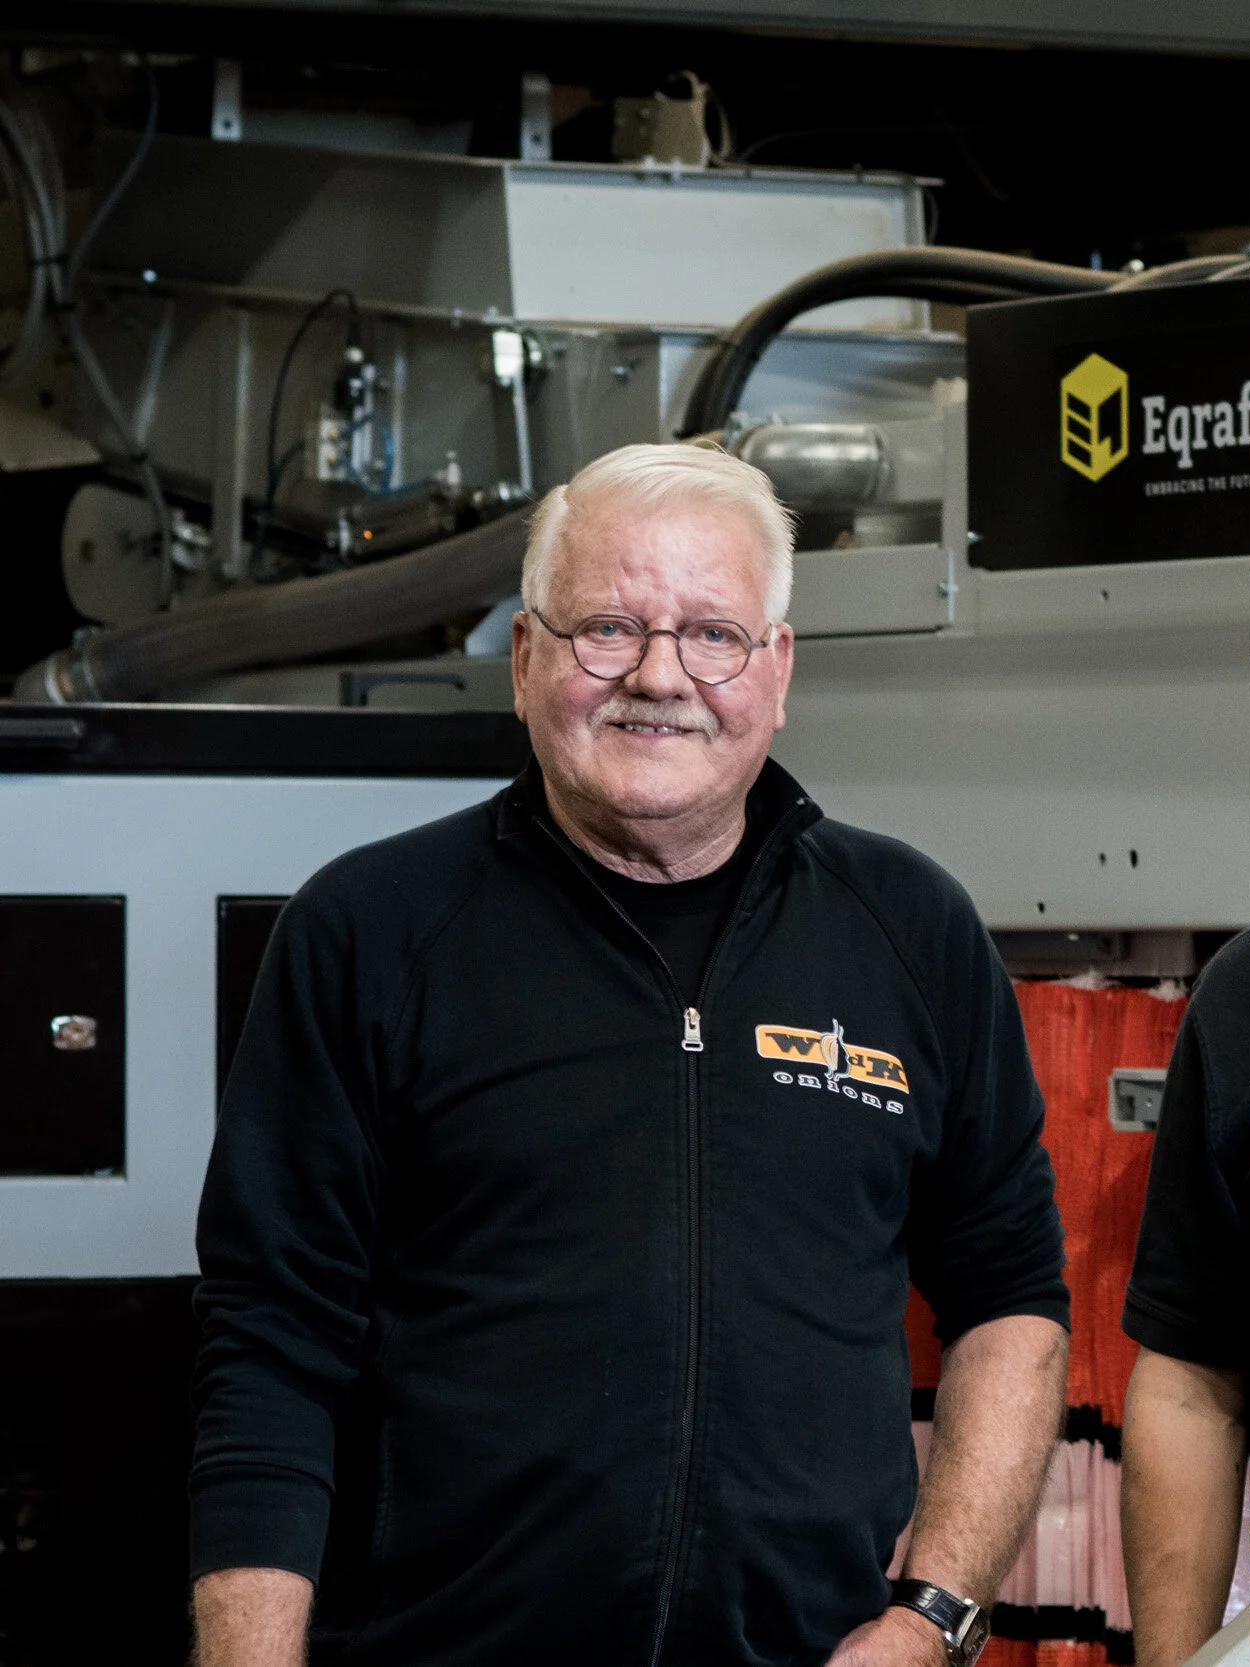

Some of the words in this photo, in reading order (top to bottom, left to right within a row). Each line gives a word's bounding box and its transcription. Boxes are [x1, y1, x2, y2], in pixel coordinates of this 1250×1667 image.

[1145, 479, 1205, 496] EMBRACING
[1207, 476, 1226, 491] THE
[773, 1071, 904, 1115] onions
